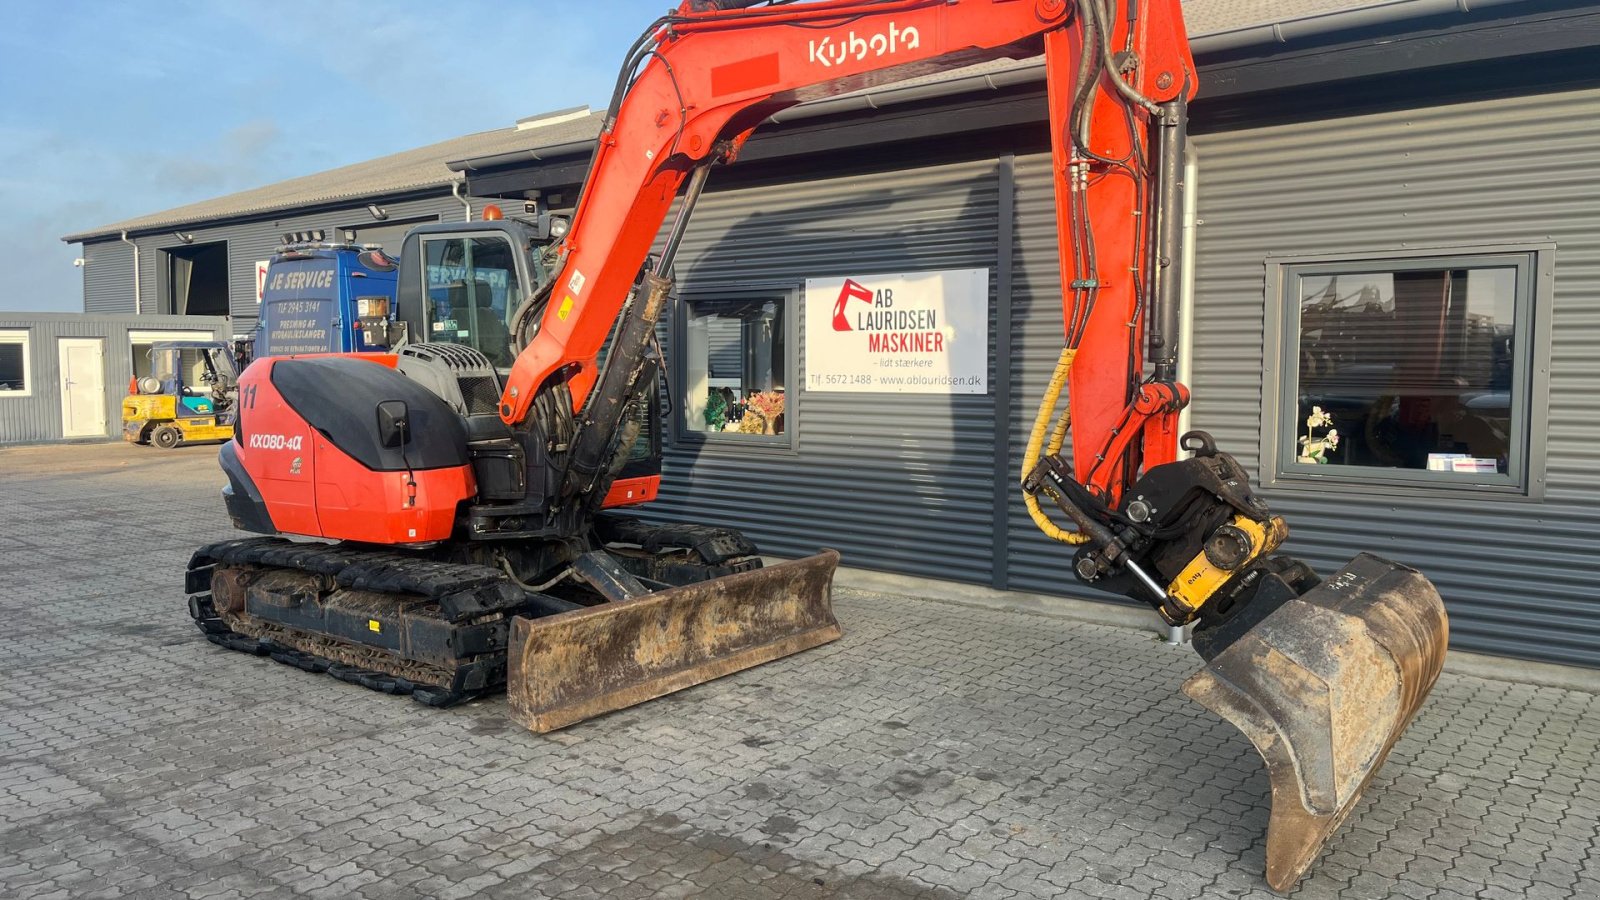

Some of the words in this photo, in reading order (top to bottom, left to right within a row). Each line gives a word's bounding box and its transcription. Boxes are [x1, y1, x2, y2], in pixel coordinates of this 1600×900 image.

[809, 21, 919, 67] Kubota
[270, 273, 284, 290] JE
[284, 270, 335, 290] SERVICE
[287, 302, 304, 313] 2945
[875, 288, 893, 309] AB
[858, 309, 936, 331] LAURIDSEN
[869, 332, 944, 353] MASKINER
[880, 358, 893, 367] lidt
[895, 358, 933, 368] stærkere
[825, 374, 847, 384] 5672
[849, 374, 872, 385] 1488
[880, 375, 982, 386] www.ablauridsen.dk
[243, 384, 257, 409] 11
